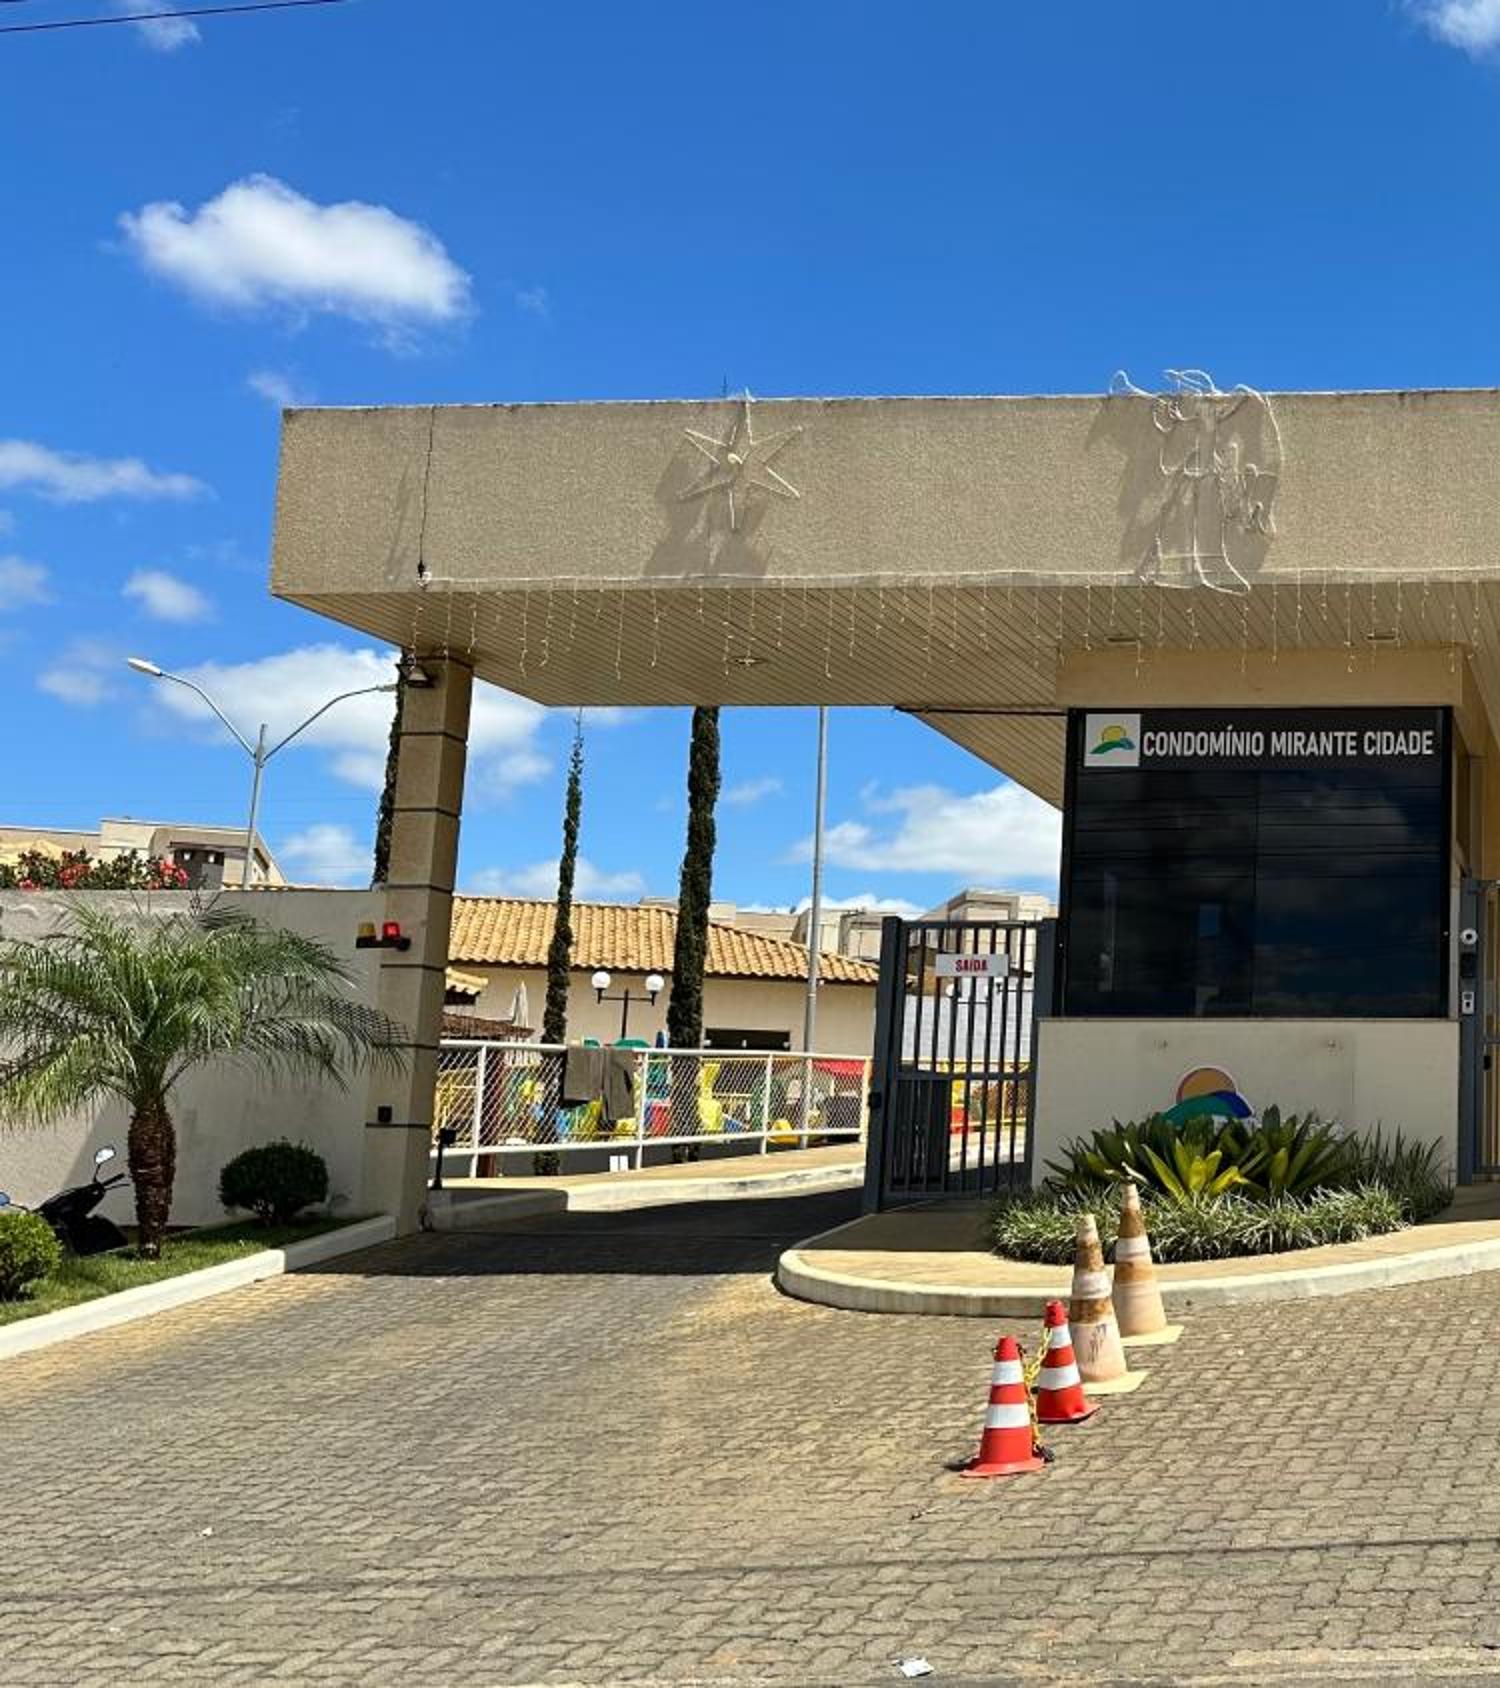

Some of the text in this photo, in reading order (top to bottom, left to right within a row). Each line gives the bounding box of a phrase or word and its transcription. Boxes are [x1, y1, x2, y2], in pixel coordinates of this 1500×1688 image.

[1143, 725, 1434, 757] CONDOMÍNIO MIRANTE CIDADE
